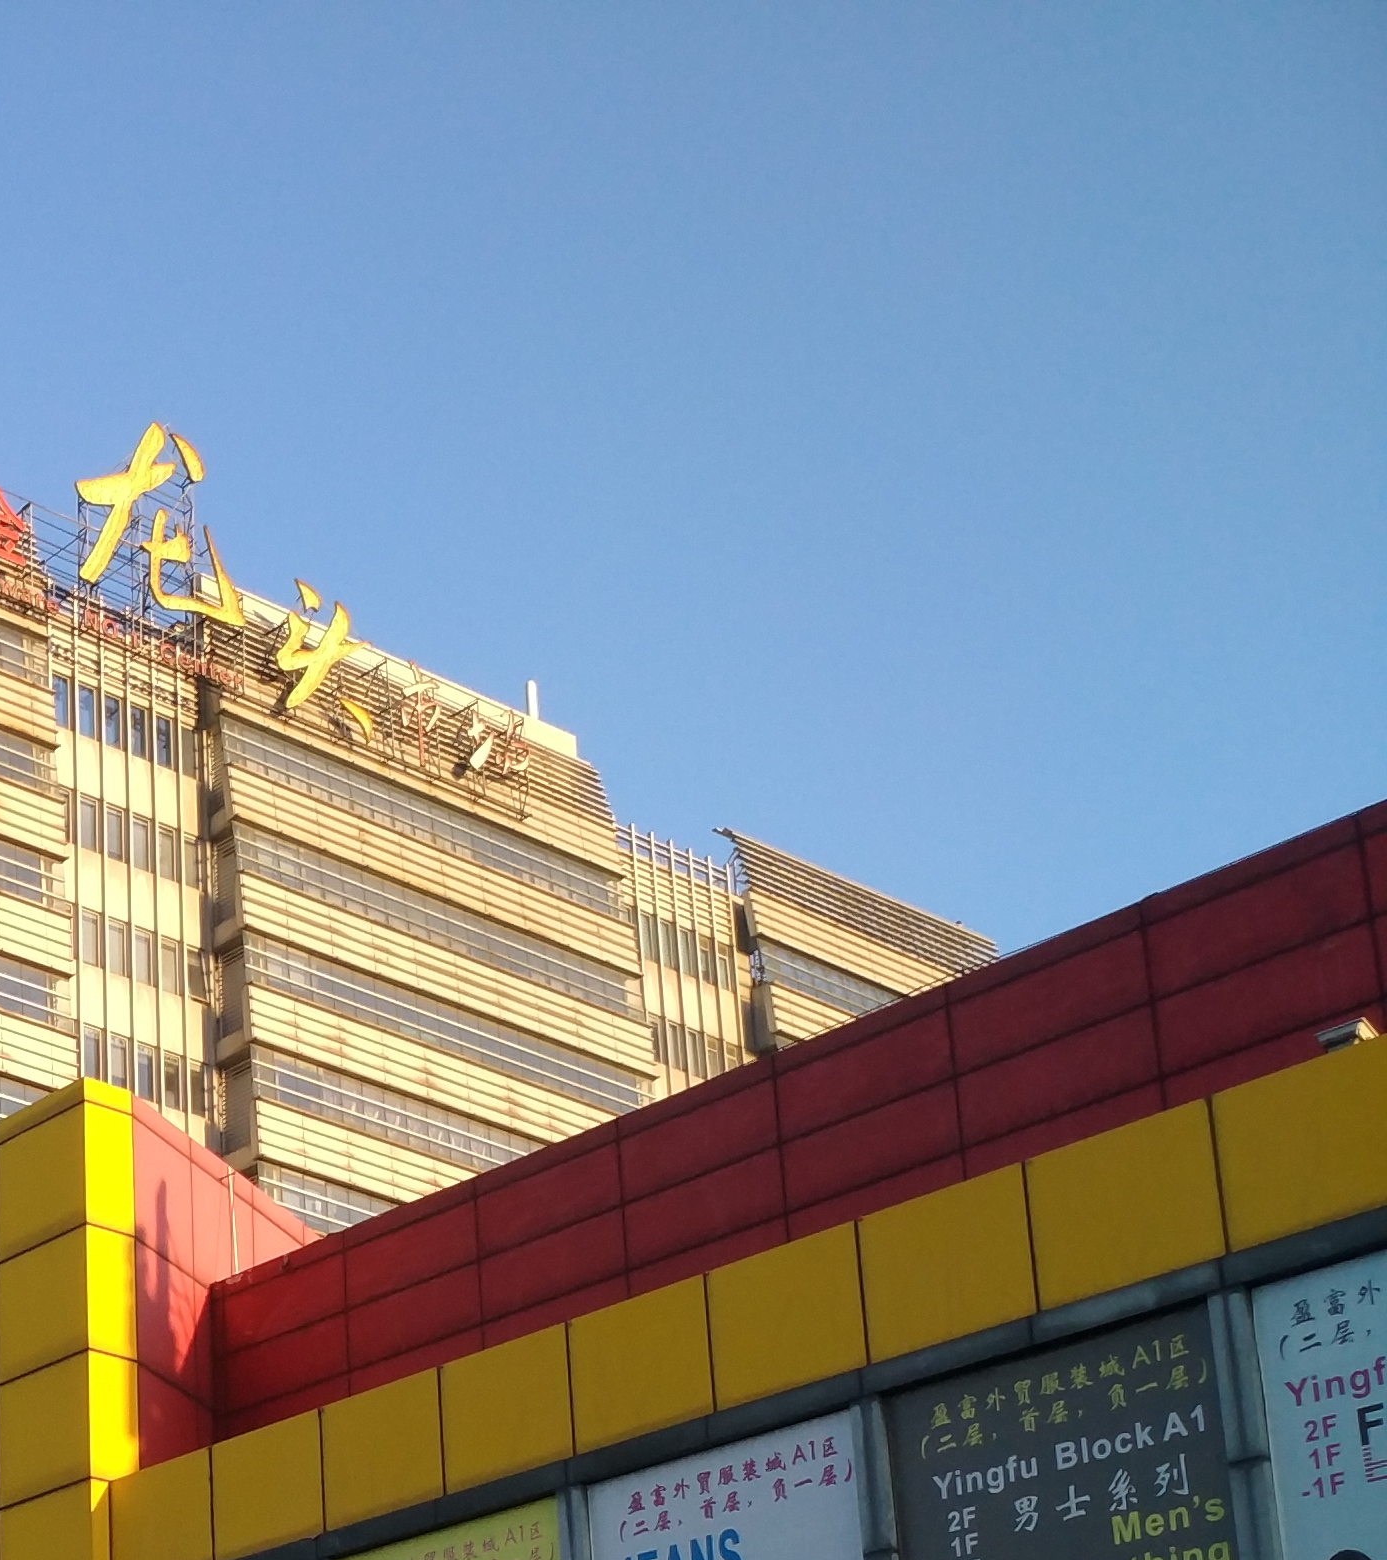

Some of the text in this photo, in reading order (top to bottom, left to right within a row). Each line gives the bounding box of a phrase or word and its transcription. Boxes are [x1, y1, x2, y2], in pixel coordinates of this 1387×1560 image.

[1304, 1414, 1337, 1442] 2F
[932, 1404, 1206, 1499] Yingfu Block A1
[1309, 1443, 1341, 1469] 1F
[1013, 1454, 1190, 1532] 男士系列
[1301, 1471, 1345, 1498] -1F
[947, 1506, 977, 1533] 2F
[949, 1532, 979, 1559] 1F
